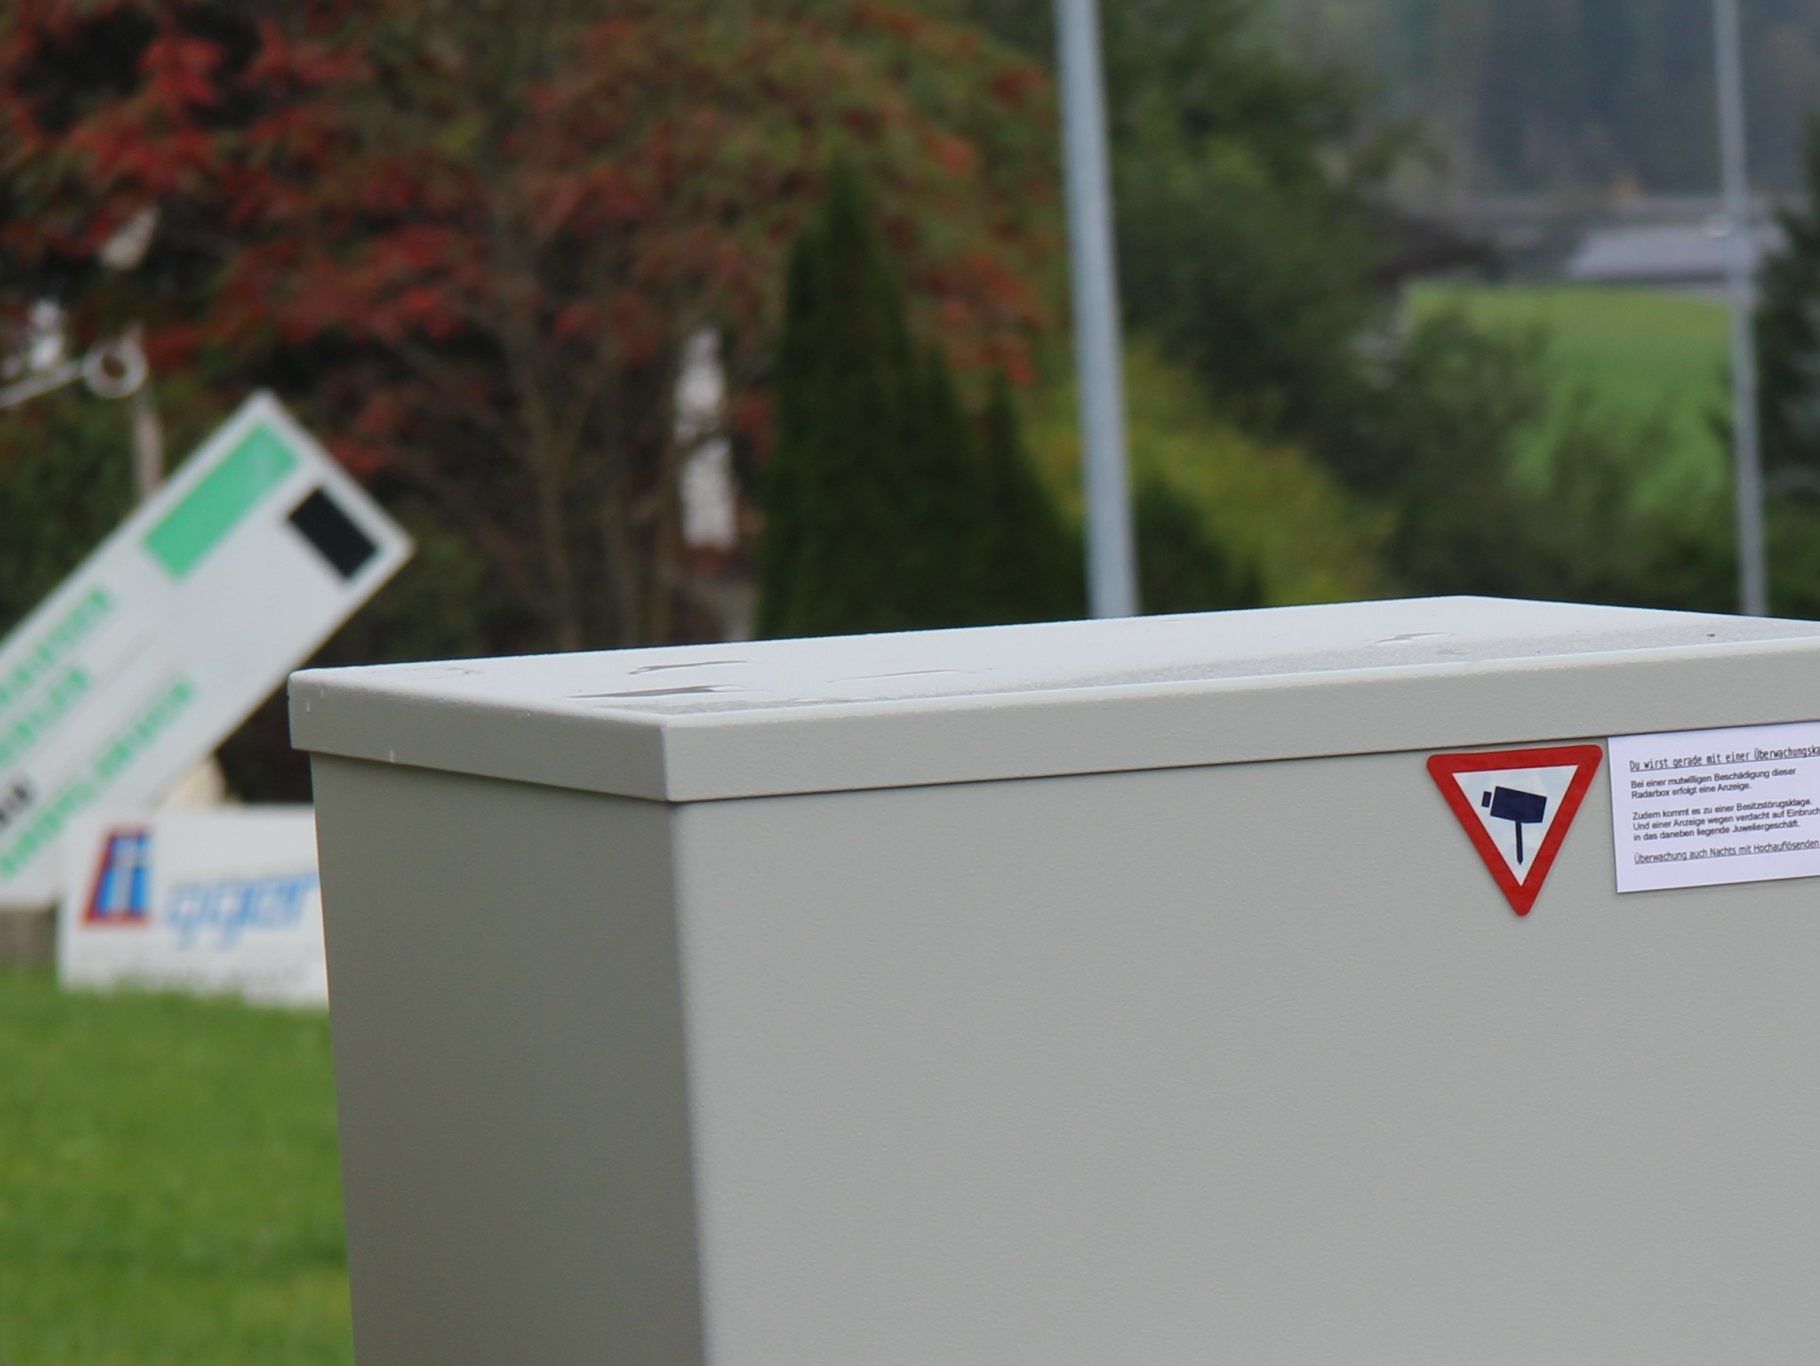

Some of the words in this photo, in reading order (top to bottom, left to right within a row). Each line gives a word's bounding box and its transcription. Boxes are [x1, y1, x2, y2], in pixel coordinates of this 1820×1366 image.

[1630, 759, 1640, 771] Du
[1644, 757, 1668, 769] wirst
[1672, 754, 1703, 768] gerade
[1706, 753, 1720, 765] mit
[1726, 751, 1750, 763] einer
[1631, 780, 1644, 788] Bei
[1646, 777, 1667, 787] einer
[1668, 773, 1712, 785] mutwilligen
[1714, 769, 1770, 780] Beschädigung
[1772, 767, 1796, 777] dieser
[1632, 788, 1670, 799] Radarbox
[1672, 785, 1697, 796] erfolgt
[1699, 785, 1716, 793] eine
[1717, 782, 1752, 792] Anzeige.
[1633, 810, 1661, 820] Zudem
[1662, 807, 1689, 818] kommt
[1691, 808, 1701, 816] es
[1703, 807, 1712, 815] zu
[1714, 804, 1734, 814] einer
[1633, 821, 1647, 830] Und
[1651, 819, 1671, 829] einer
[1673, 817, 1706, 828] Anzeige
[1708, 814, 1734, 825] wegen
[1736, 810, 1770, 821] verdacht
[1772, 809, 1785, 818] auf
[1787, 806, 1820, 817] Einbruch
[1634, 832, 1641, 840] in
[1642, 829, 1657, 839] das
[1660, 827, 1695, 838] daneben
[1697, 824, 1731, 835] liegende
[1634, 853, 1687, 864] Überwachung
[1689, 848, 1708, 860] auch
[1710, 846, 1736, 857] Nachts
[1739, 845, 1752, 855] mit
